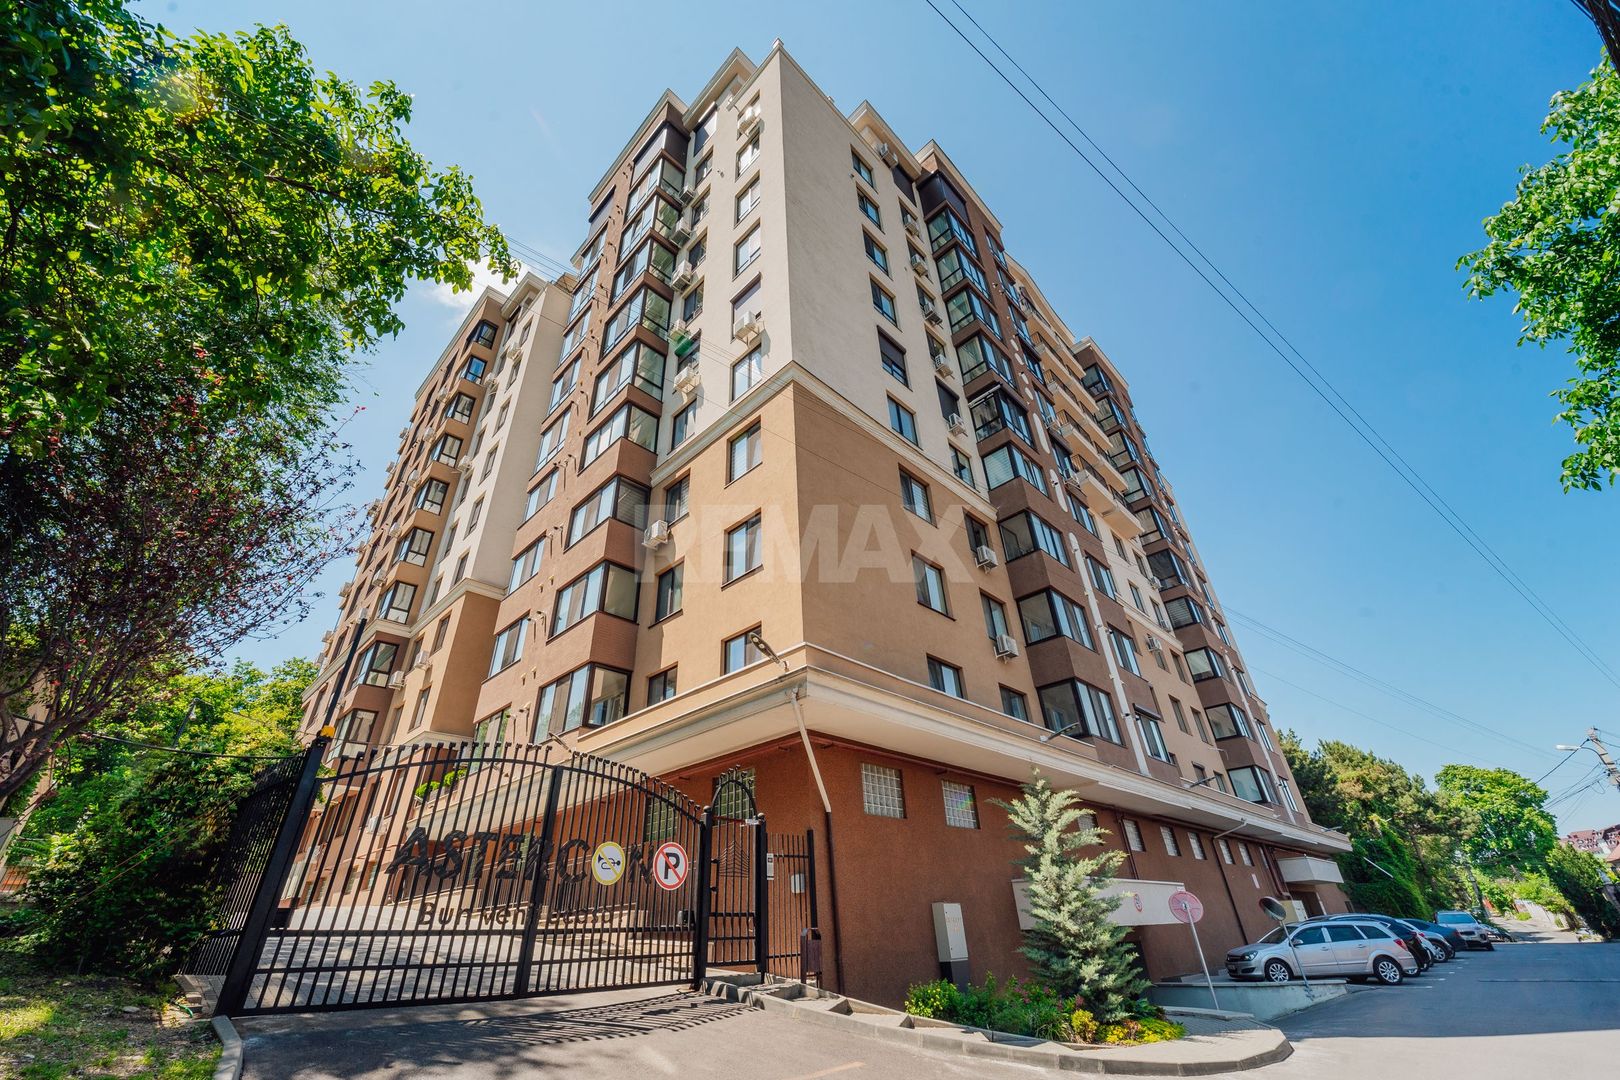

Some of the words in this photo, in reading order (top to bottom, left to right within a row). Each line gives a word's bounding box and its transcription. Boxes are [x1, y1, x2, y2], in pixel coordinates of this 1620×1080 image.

[385, 827, 654, 885] ASTERCN
[664, 852, 680, 879] P
[415, 901, 469, 926] Bun
